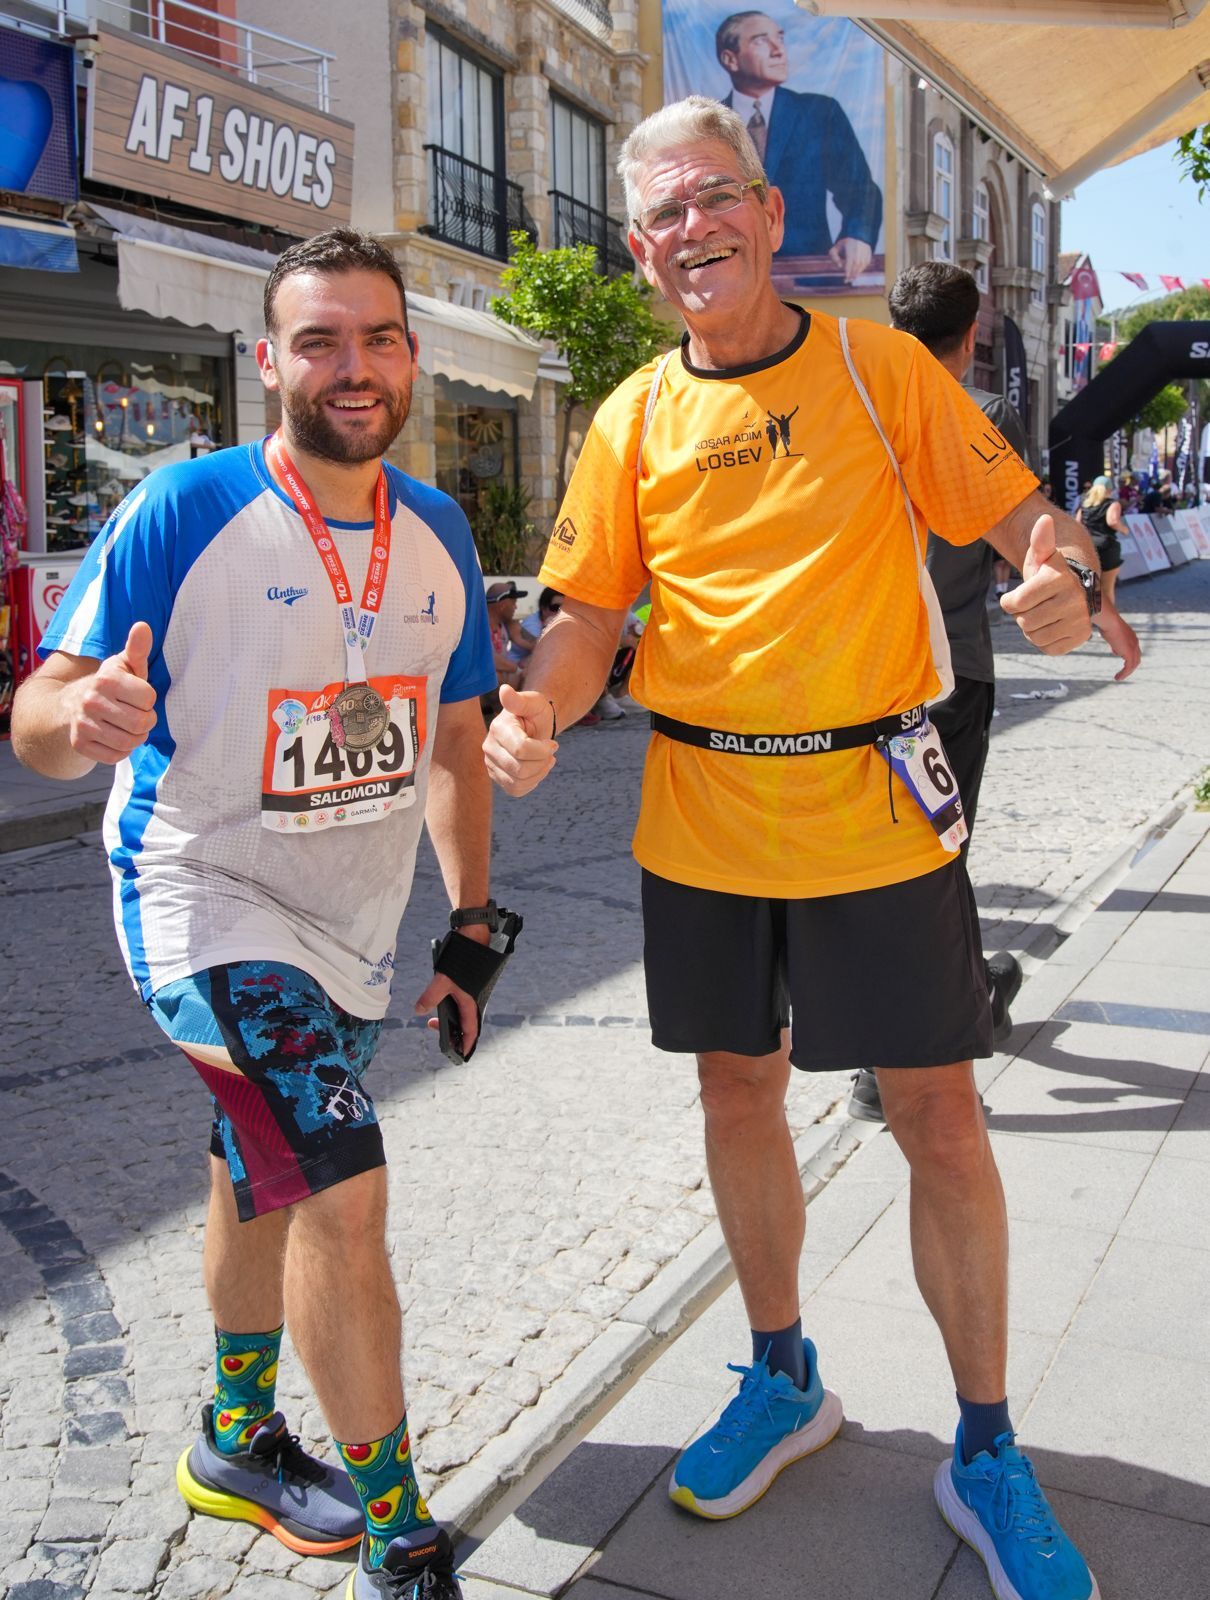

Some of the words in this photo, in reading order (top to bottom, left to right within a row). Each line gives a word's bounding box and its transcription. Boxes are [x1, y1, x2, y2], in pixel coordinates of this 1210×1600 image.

[125, 73, 191, 163] AF
[188, 94, 214, 174] 1
[218, 105, 336, 209] SHOES
[285, 473, 311, 511] SALOMON
[336, 577, 348, 600] 10K
[366, 586, 380, 608] 10K
[709, 732, 832, 754] SALOMON
[922, 747, 954, 796] 6
[310, 782, 390, 807] SALOMON
[351, 806, 378, 817] GARMIN
[408, 1544, 437, 1558] saucony
